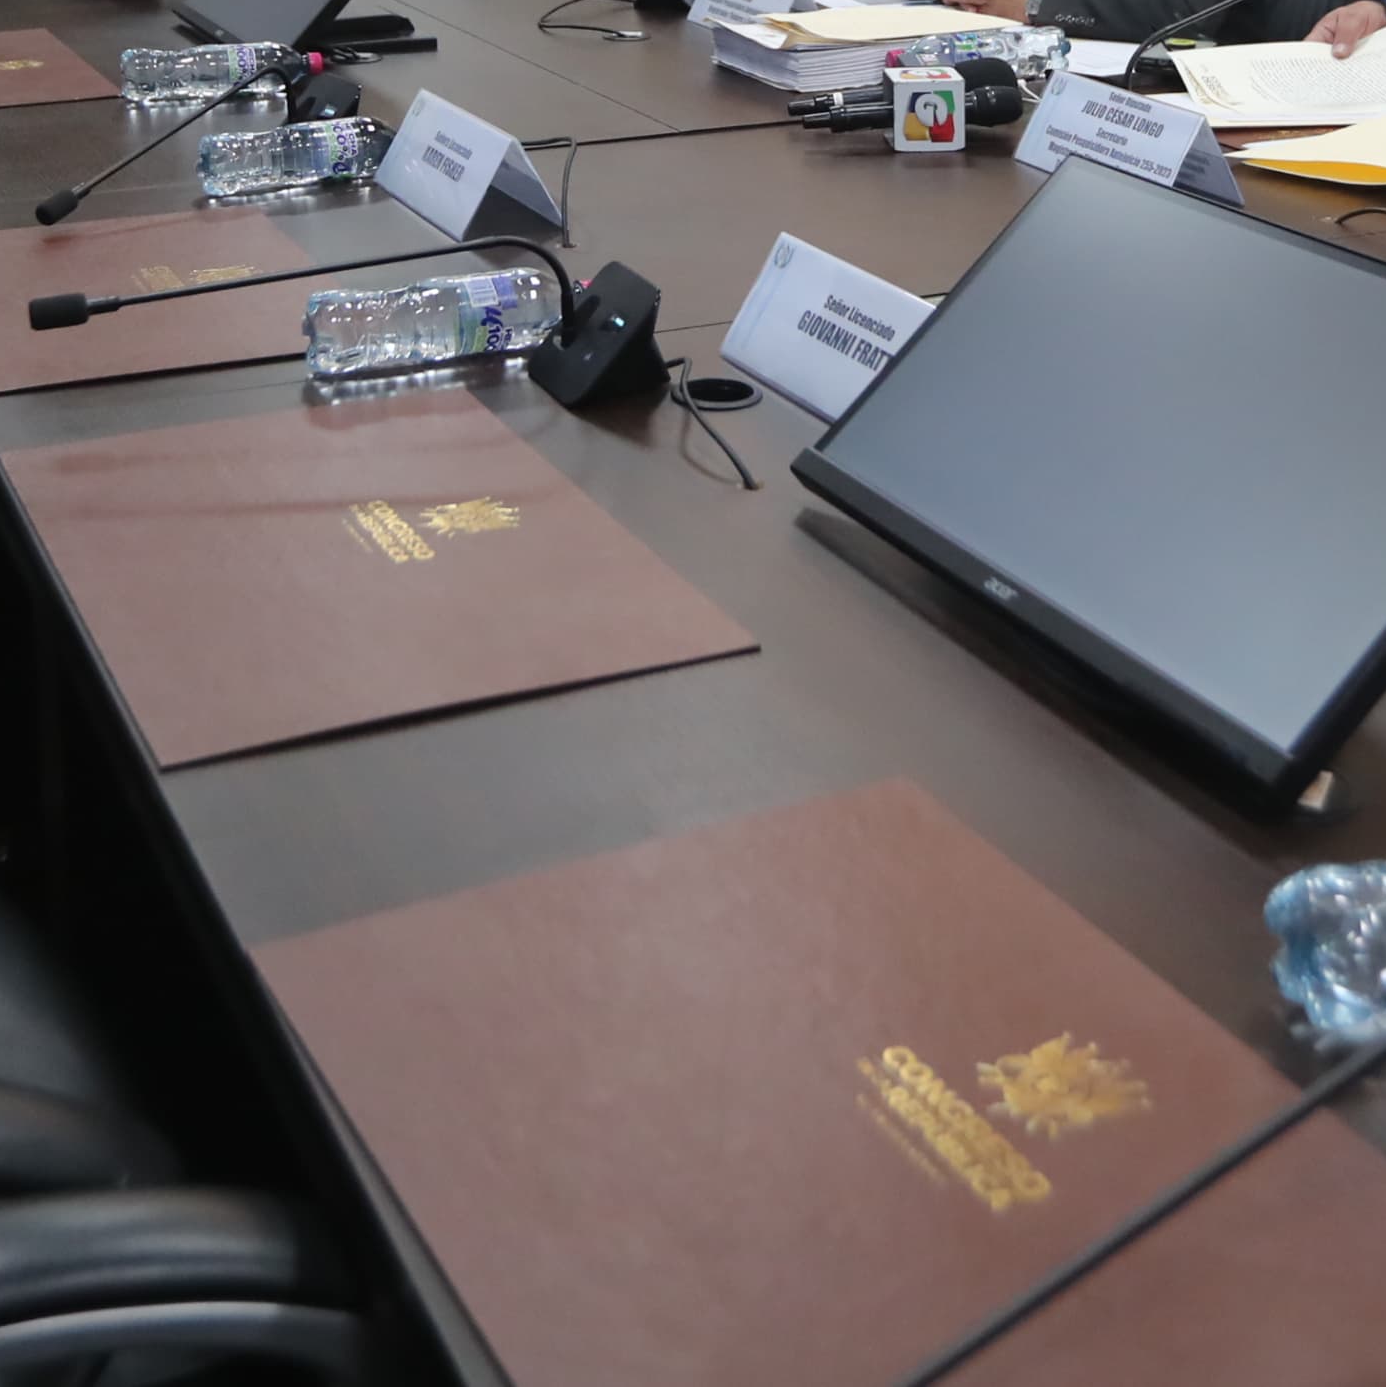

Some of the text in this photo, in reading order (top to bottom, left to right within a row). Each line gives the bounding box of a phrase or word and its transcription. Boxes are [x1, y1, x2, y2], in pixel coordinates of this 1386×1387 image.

[1081, 100, 1105, 118] JULIO
[1133, 117, 1165, 139] LONGO
[797, 310, 858, 356] GIOVANNI
[824, 294, 896, 342] Señor Licenciado
